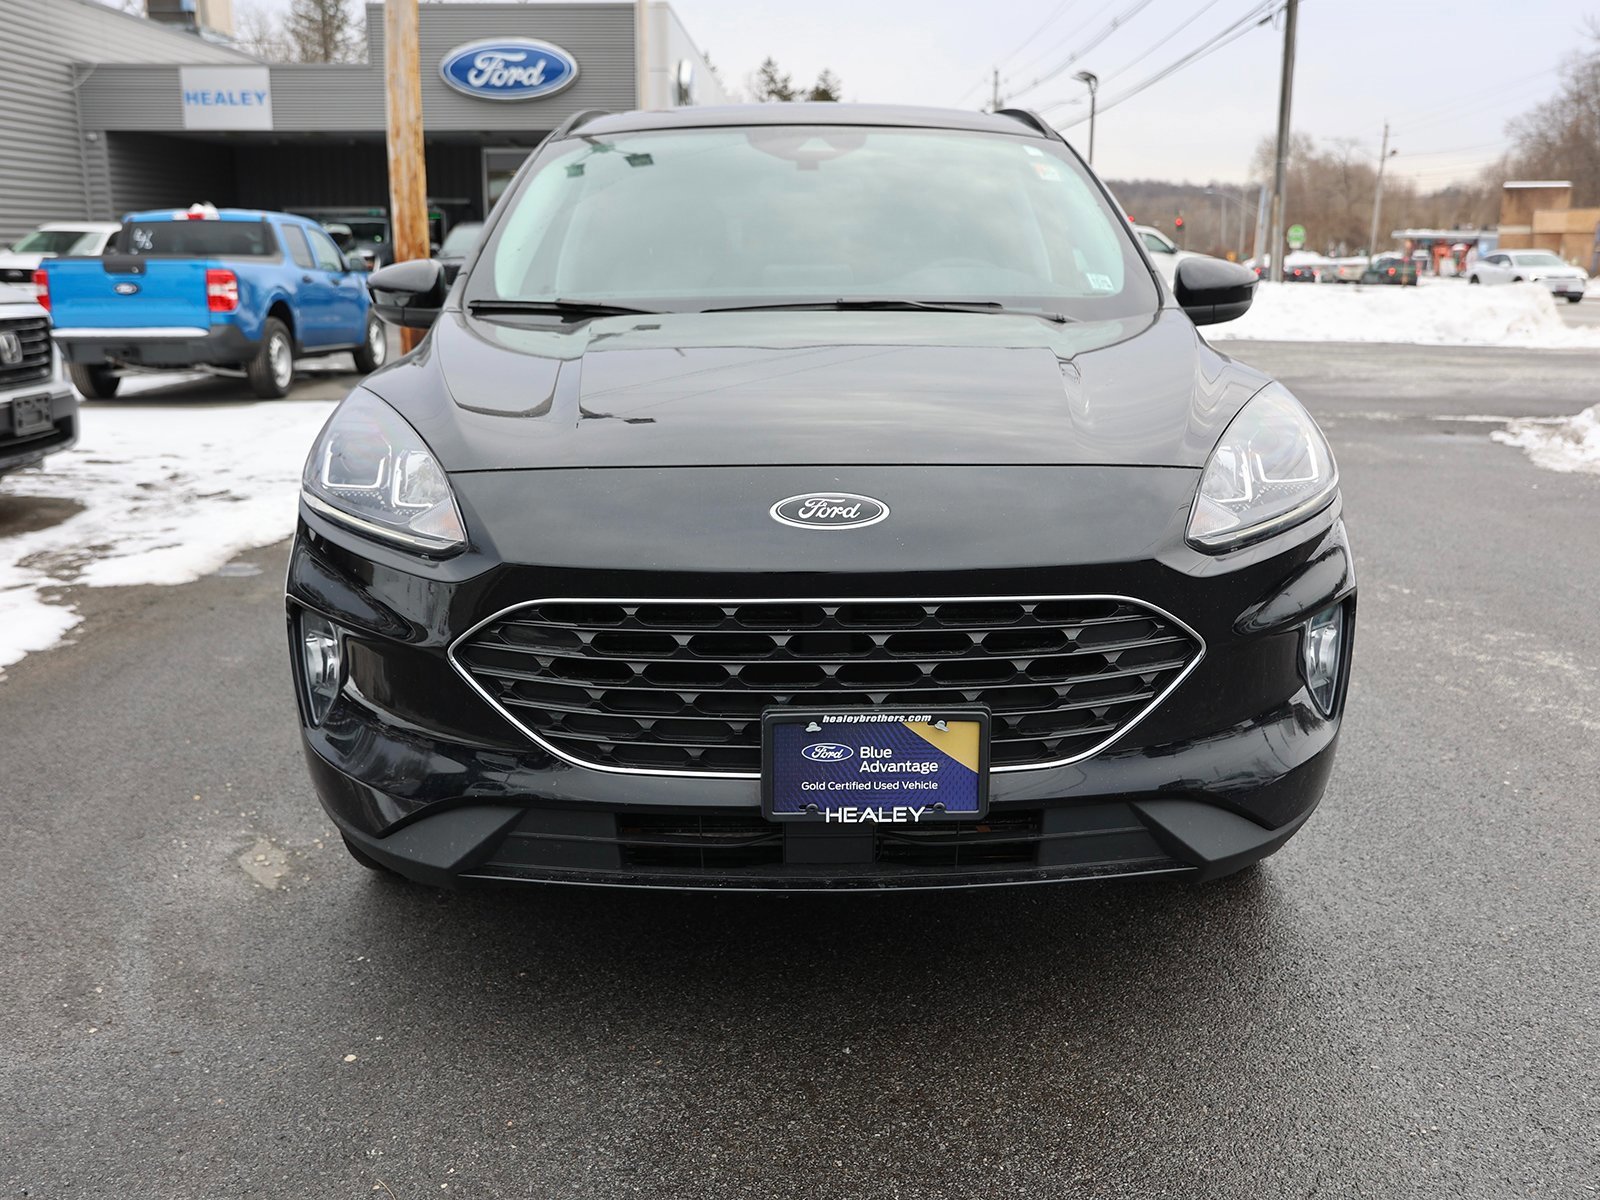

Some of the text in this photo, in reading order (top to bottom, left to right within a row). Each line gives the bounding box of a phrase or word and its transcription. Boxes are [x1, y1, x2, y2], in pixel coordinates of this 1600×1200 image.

[467, 51, 547, 87] Ford
[184, 91, 266, 106] HEALEY
[798, 498, 861, 519] Ford
[822, 714, 932, 723] healeybrothers.com
[811, 745, 843, 760] Ford
[860, 746, 892, 759] Blue
[859, 760, 939, 774] Advantage
[801, 780, 938, 791] Gold Certified Used Vehicle
[825, 806, 926, 823] HEALEY
